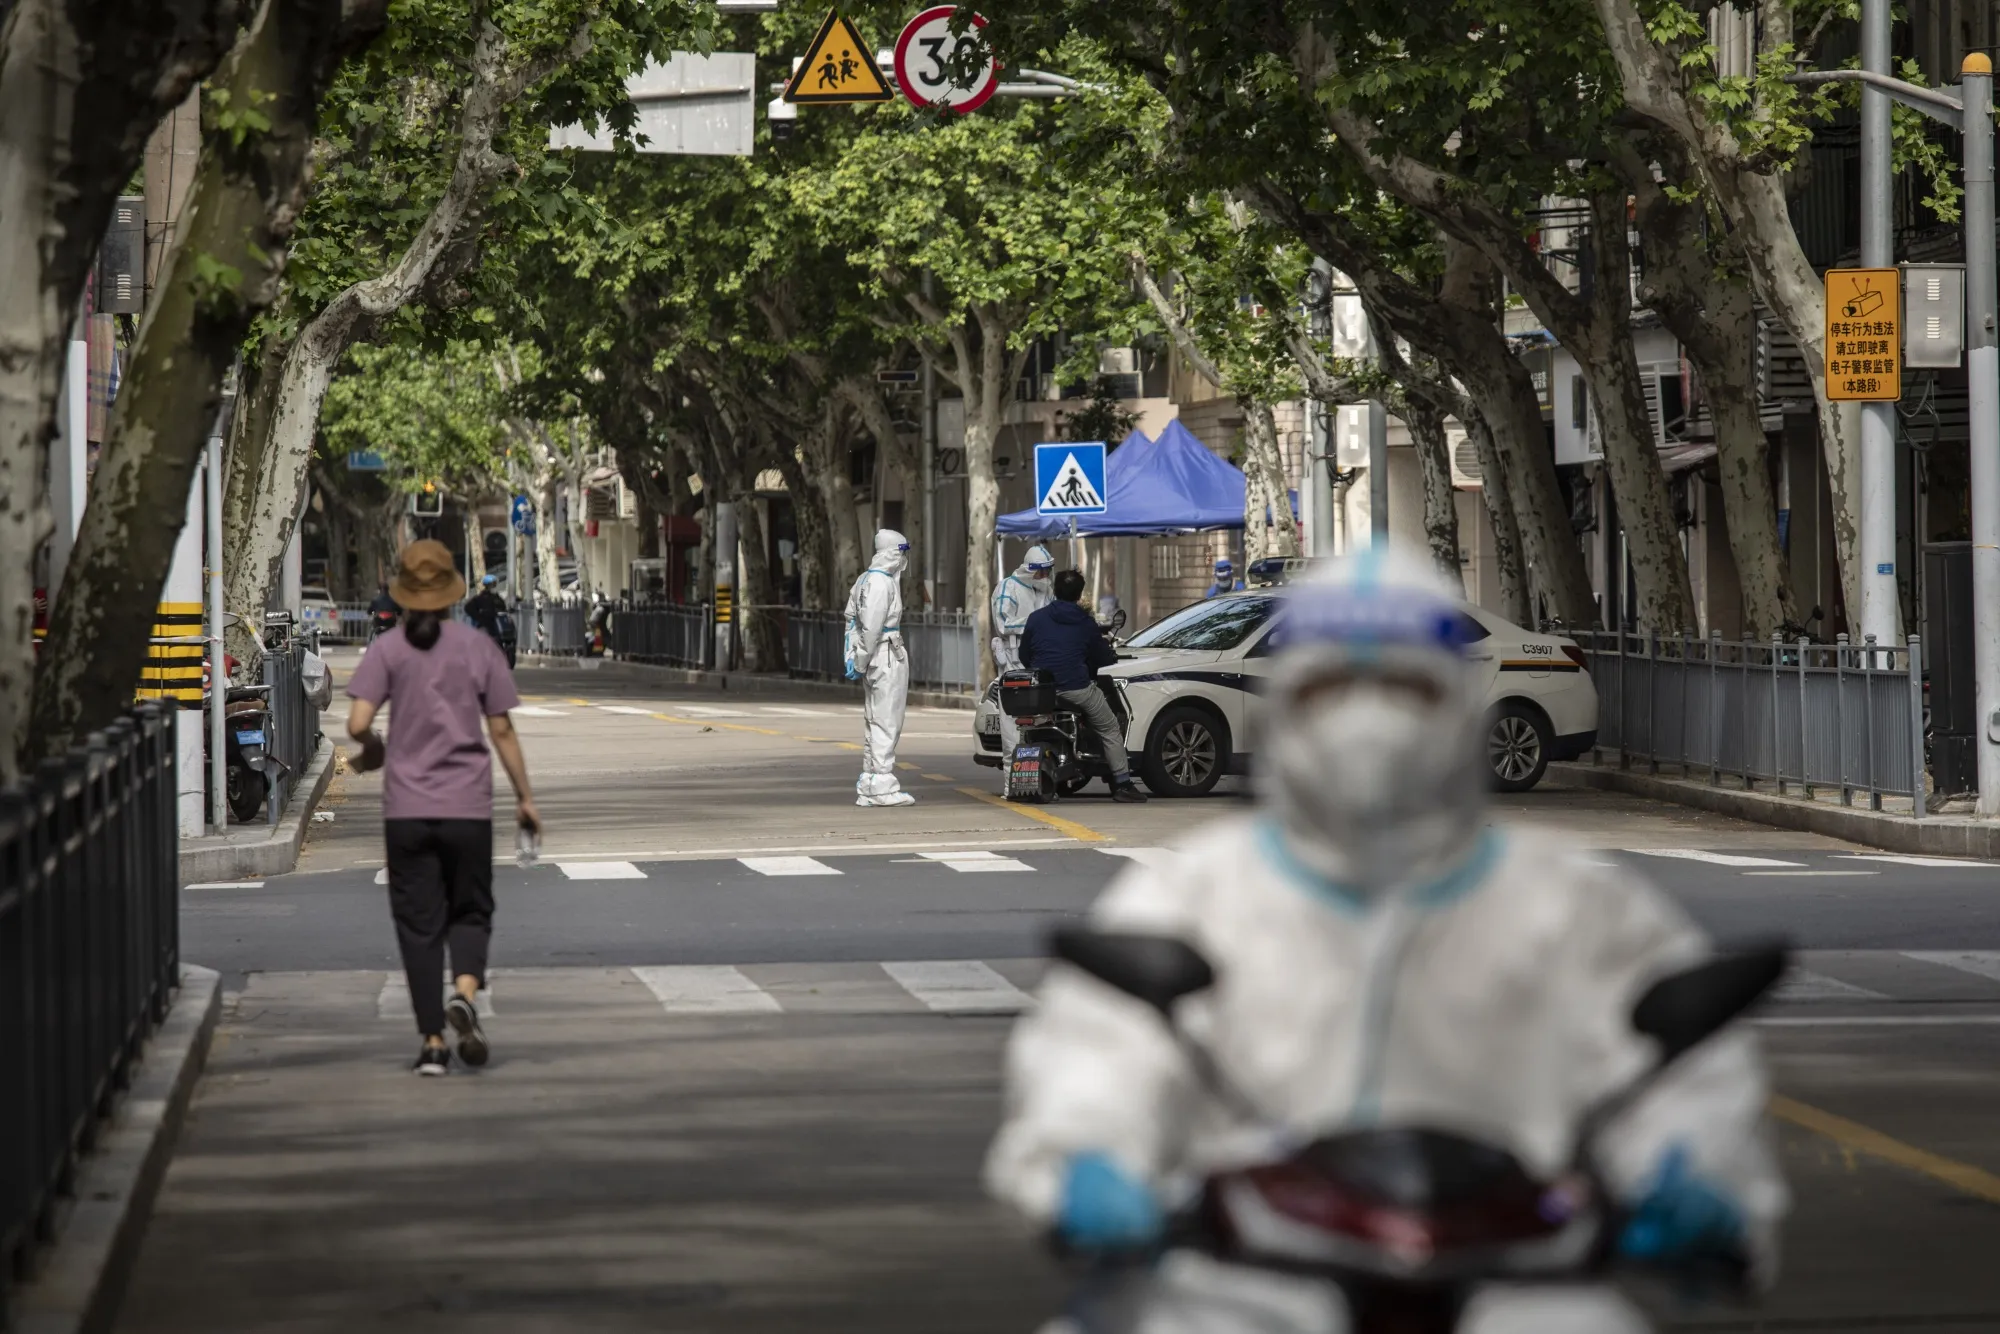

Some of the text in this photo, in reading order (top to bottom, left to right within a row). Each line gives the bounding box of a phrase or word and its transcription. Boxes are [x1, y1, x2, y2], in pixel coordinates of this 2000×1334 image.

[1830, 321, 1894, 338] 停车行为违法
[1836, 340, 1889, 356] 请立即驶离
[1830, 359, 1894, 375] 电子警察监管
[1522, 644, 1553, 655] C3907
